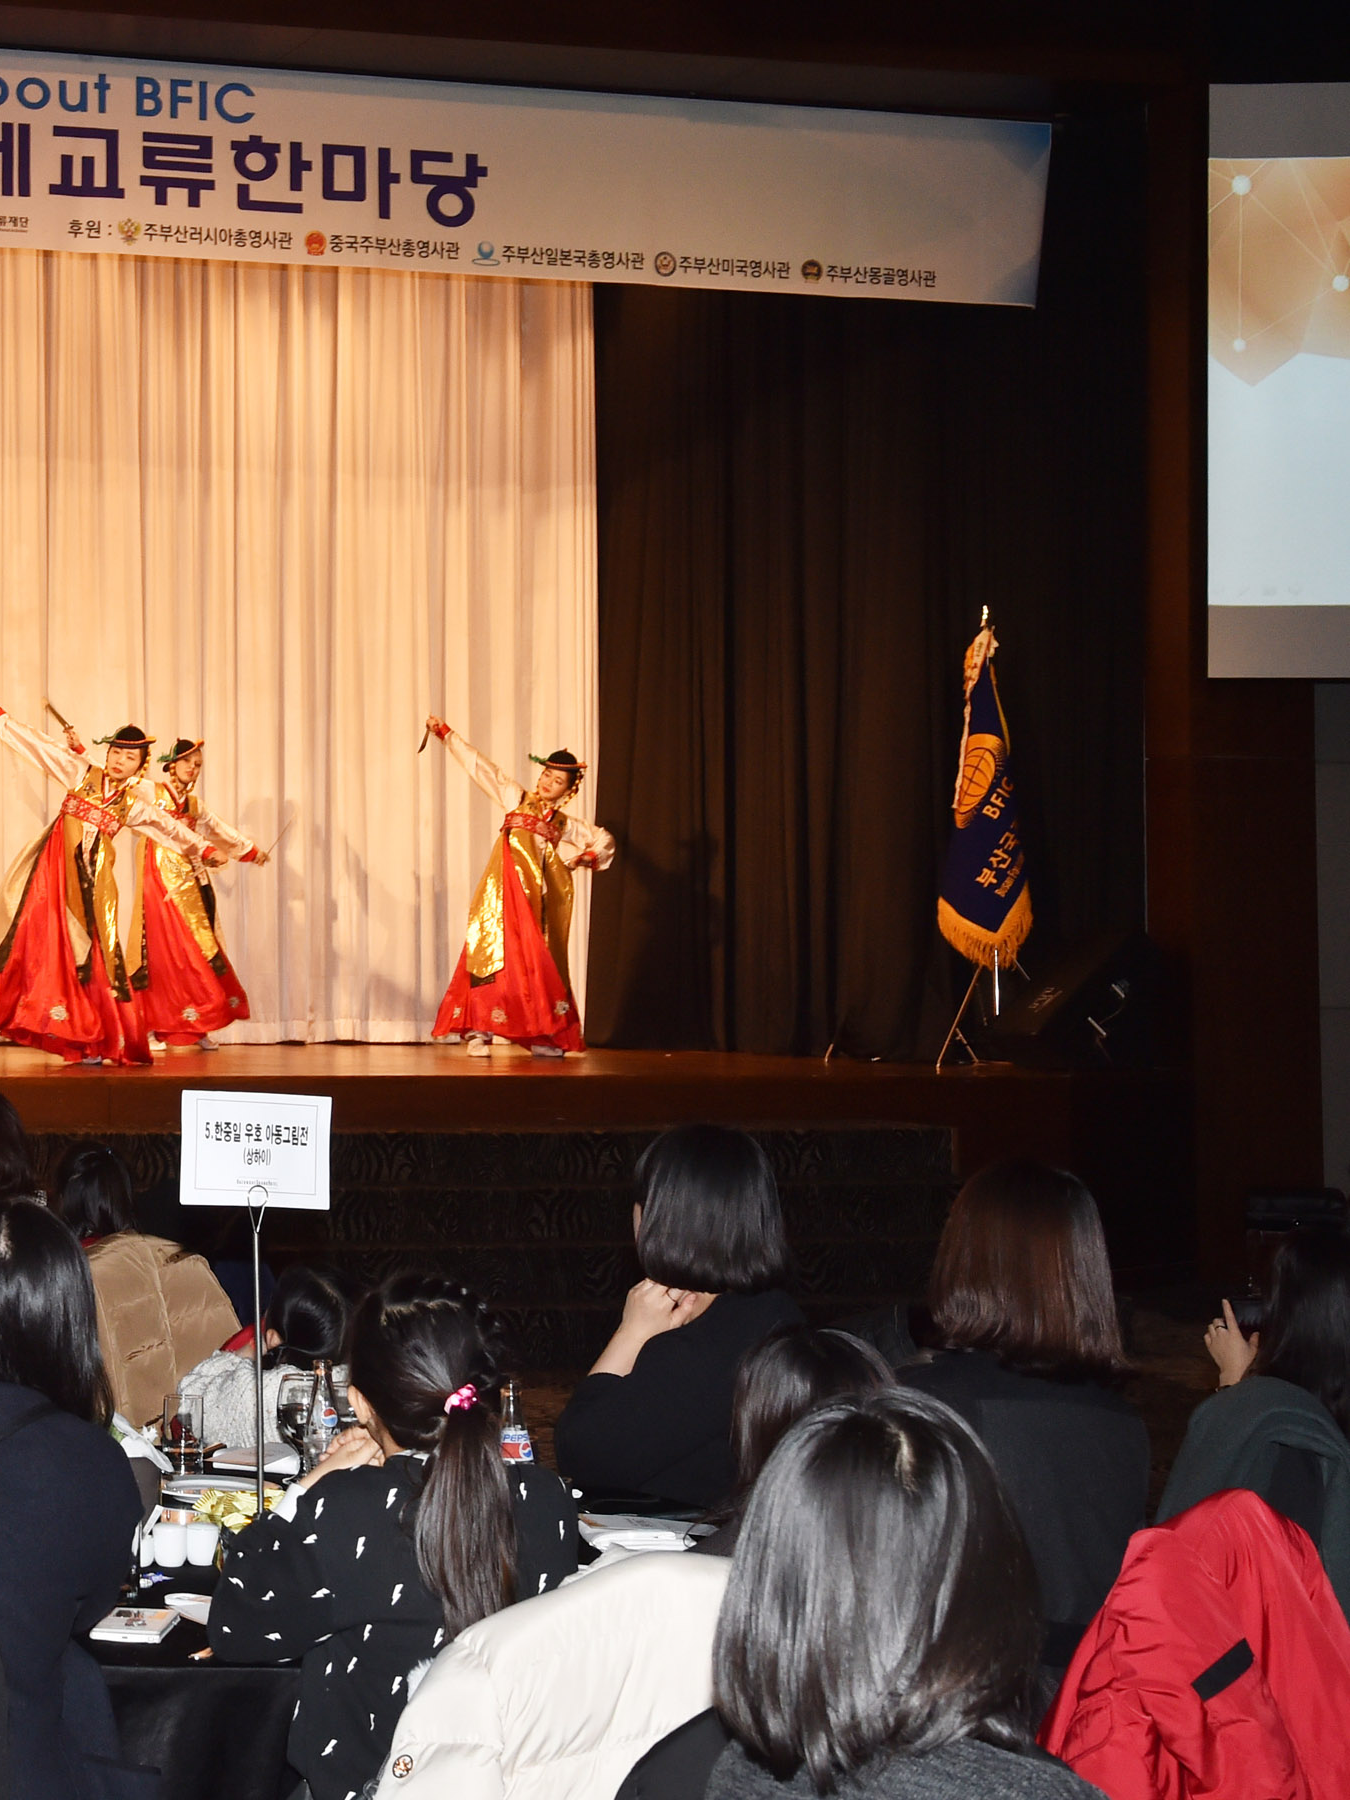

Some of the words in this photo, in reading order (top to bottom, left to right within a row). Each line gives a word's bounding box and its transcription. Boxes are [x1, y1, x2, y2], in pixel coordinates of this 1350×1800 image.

[134, 76, 258, 126] BFIC
[67, 219, 102, 240] 후원
[144, 223, 293, 251] 주부산러시아총영사관
[329, 233, 461, 261] 중국주부산총영사관
[502, 243, 646, 271] 주부산일본국총영사관
[679, 254, 791, 280] 주부산미국영사관
[826, 263, 938, 288] 주부산몽골영사관
[982, 776, 1014, 821] BFIC
[205, 1121, 242, 1143] 5.한중일
[244, 1123, 263, 1143] 우호
[265, 1124, 309, 1146] 아동그림전
[243, 1147, 272, 1166] (상하이)
